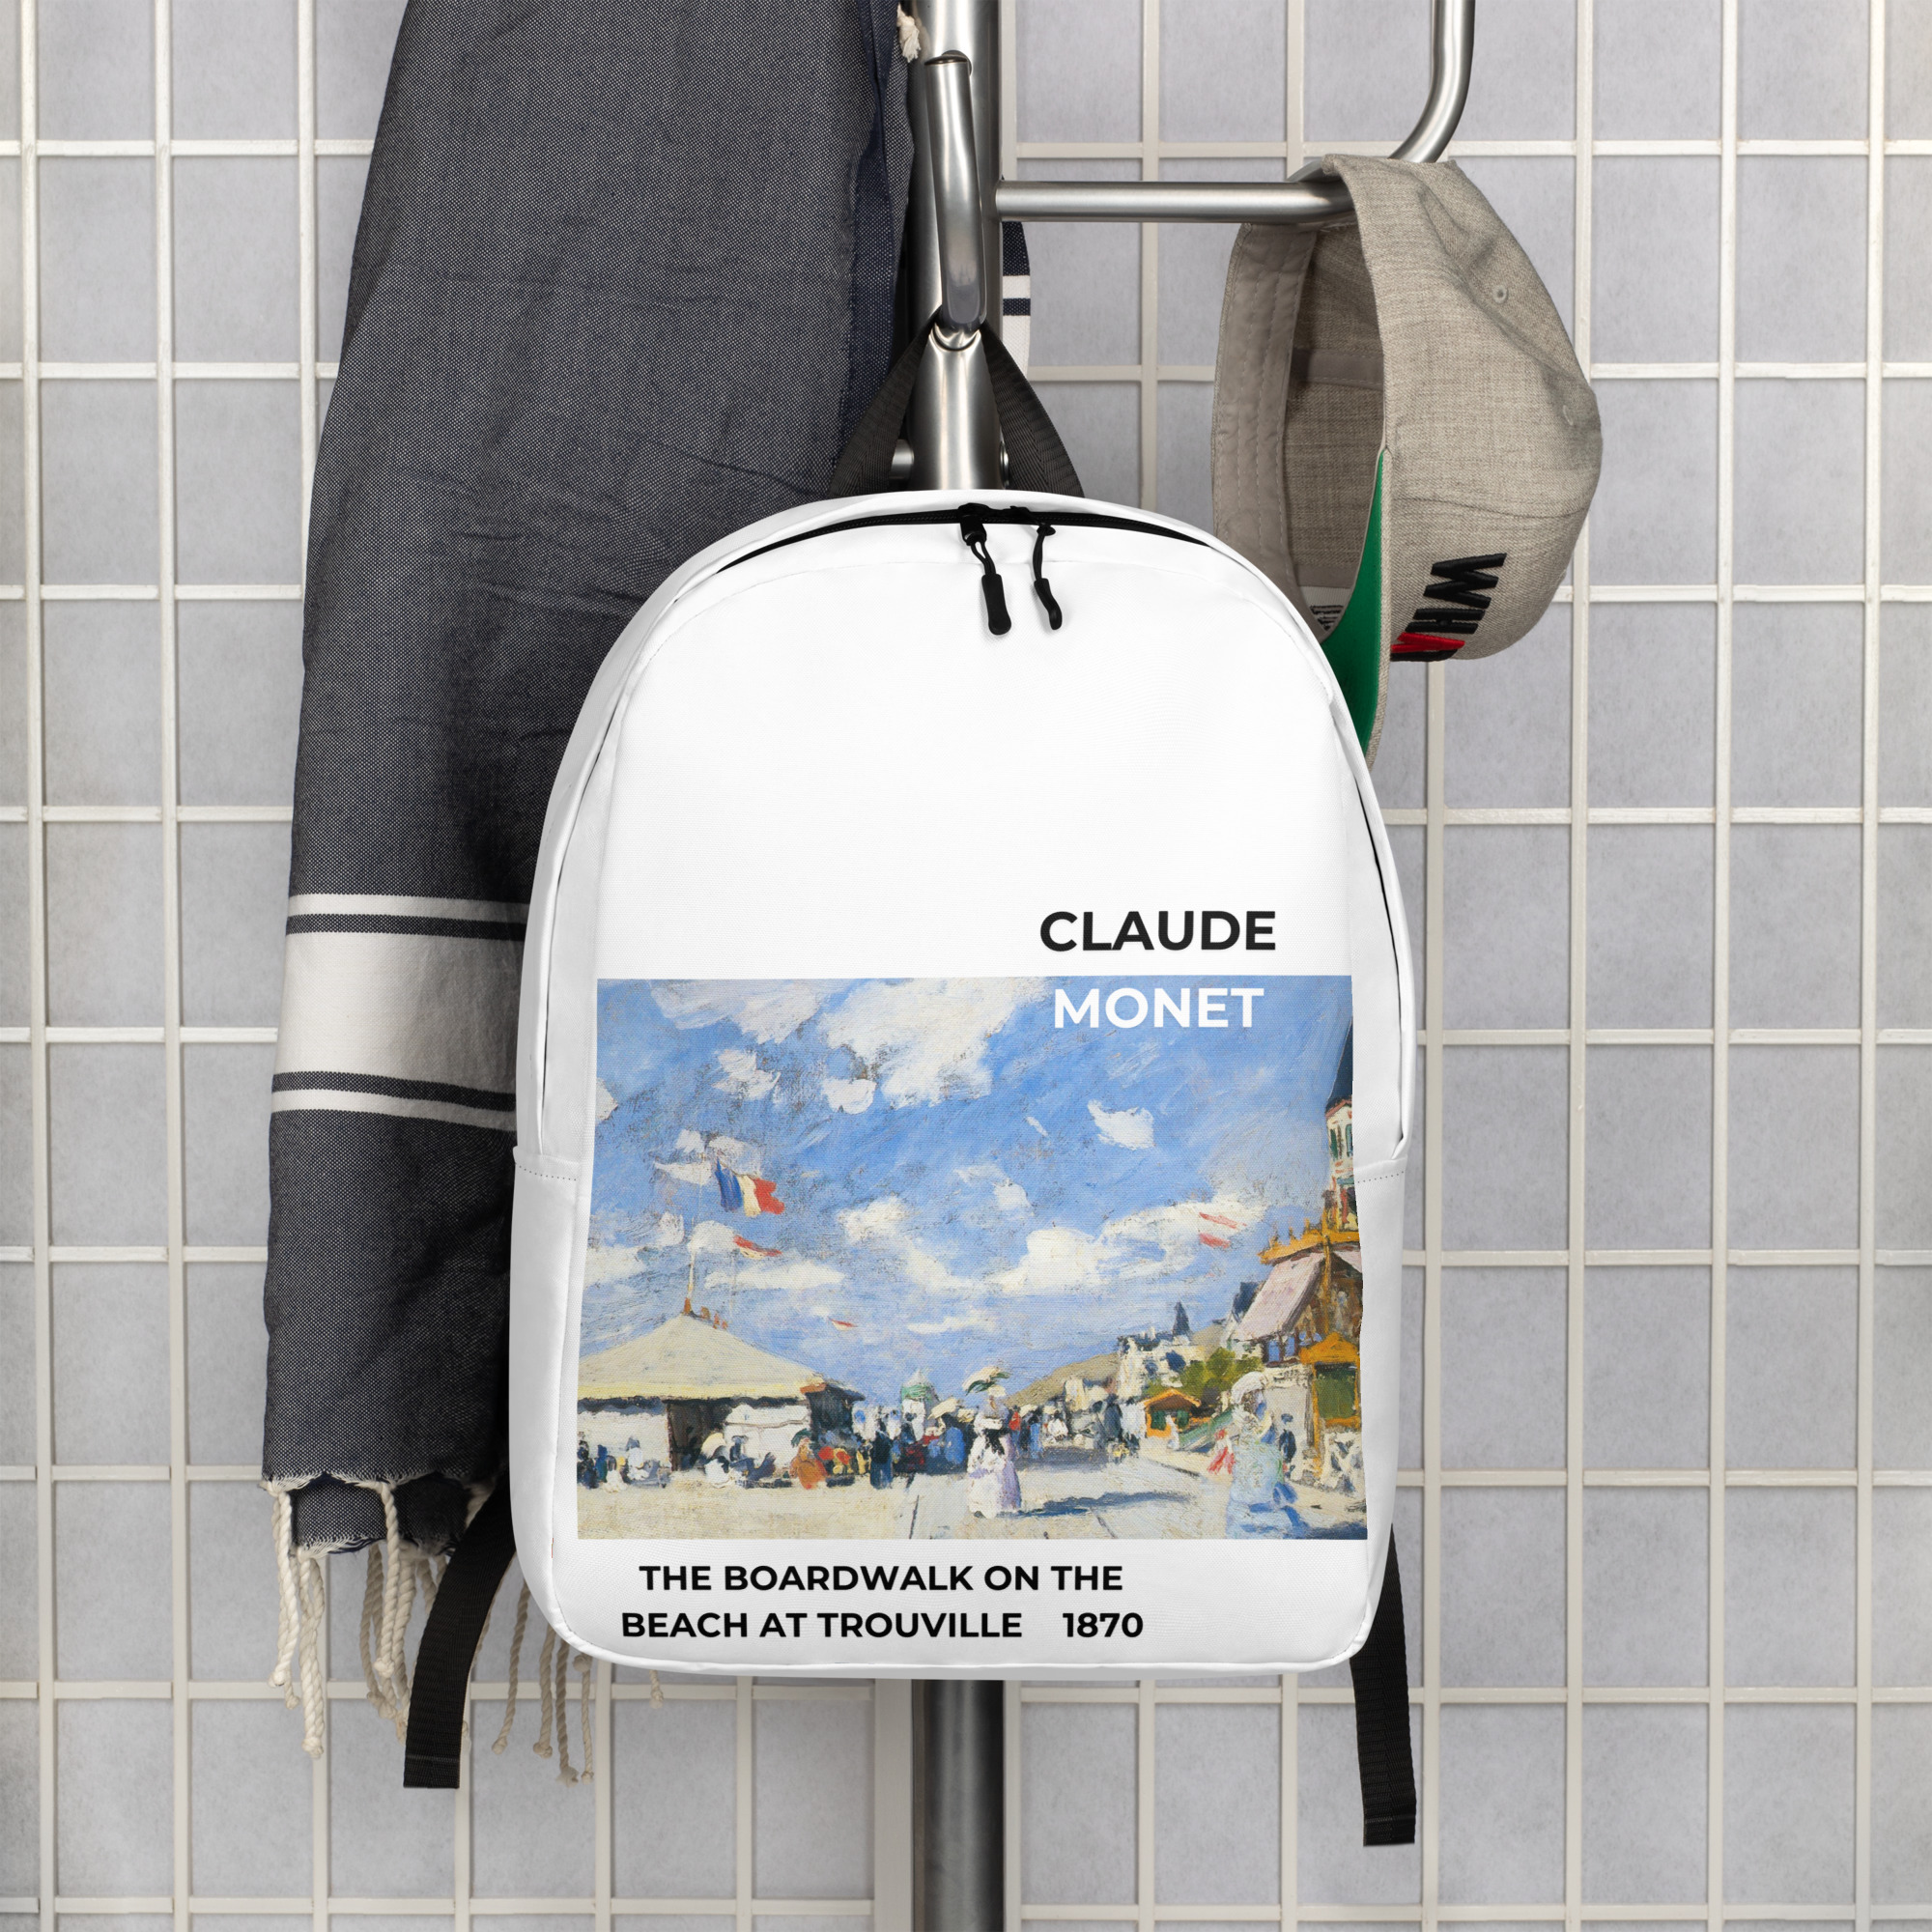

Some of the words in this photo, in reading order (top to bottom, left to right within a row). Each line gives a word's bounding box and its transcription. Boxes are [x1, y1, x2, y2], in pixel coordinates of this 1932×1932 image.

[1039, 910, 1276, 952] CLAUDE
[1054, 987, 1264, 1029] MONET
[639, 1565, 712, 1591] THE
[724, 1565, 974, 1591] BOARDWALK
[983, 1565, 1039, 1591] ON
[1050, 1565, 1123, 1591] THE
[621, 1611, 748, 1638] BEACH
[758, 1612, 809, 1638] AT
[816, 1611, 1023, 1638] TROUVILLE
[1062, 1611, 1144, 1638] 1870
